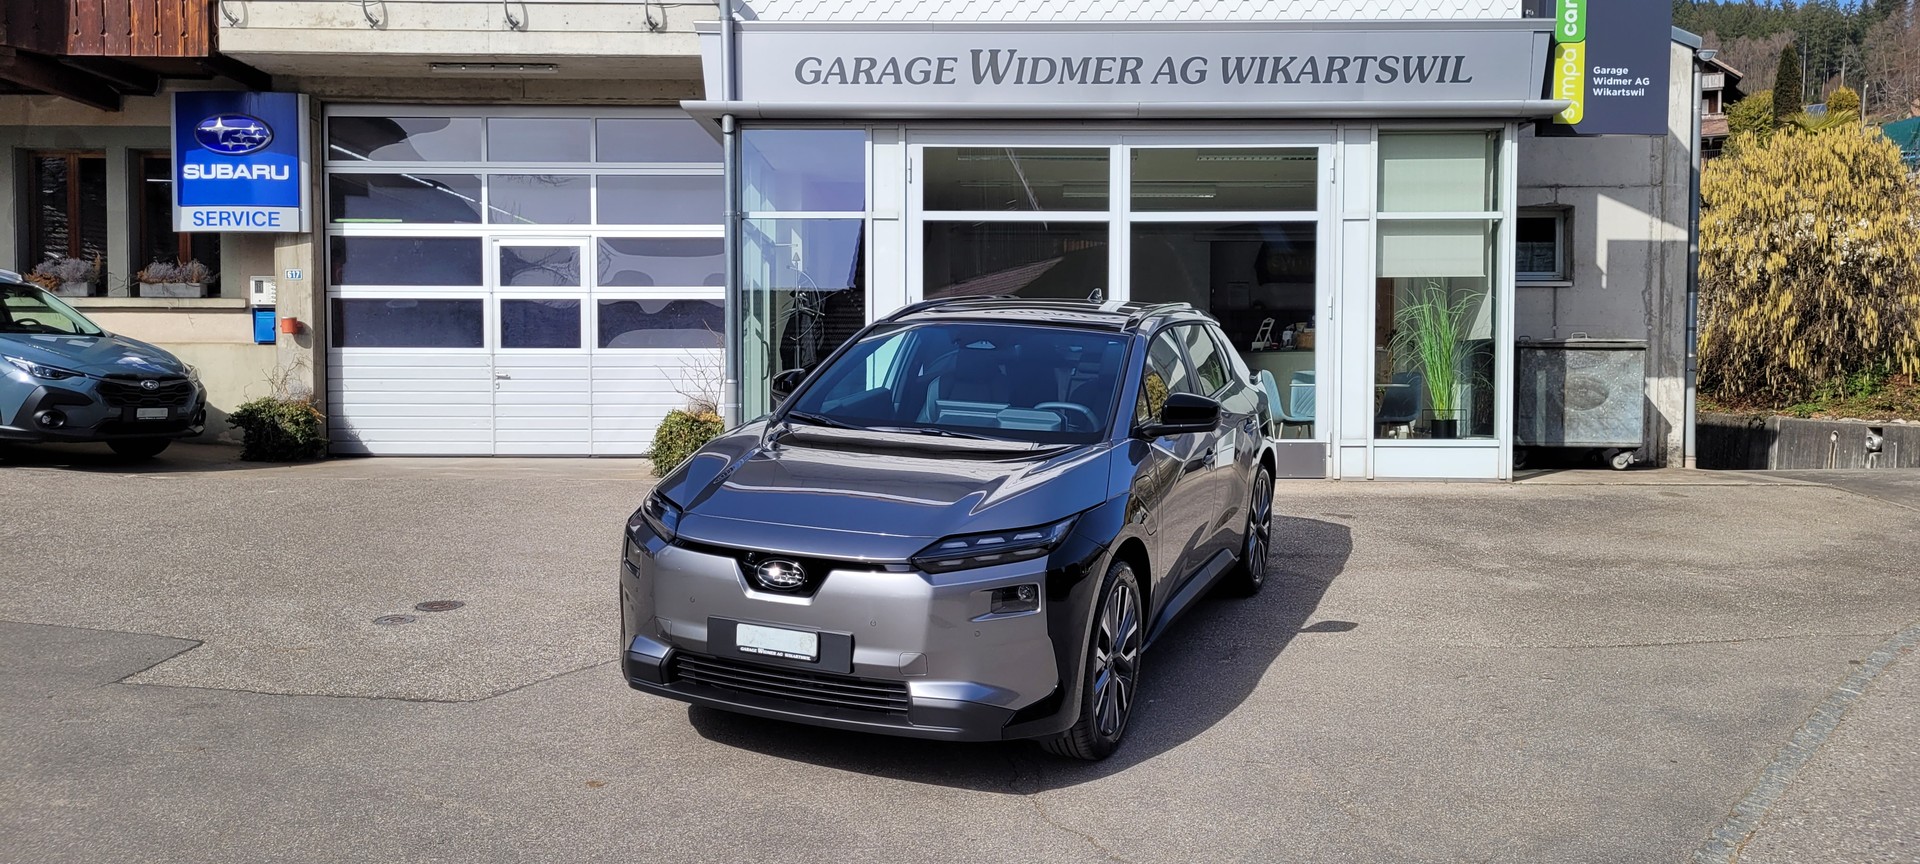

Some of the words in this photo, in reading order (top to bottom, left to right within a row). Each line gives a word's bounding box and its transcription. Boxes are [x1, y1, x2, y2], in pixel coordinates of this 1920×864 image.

[1564, 0, 1578, 36] car
[794, 56, 958, 85] GARAGE
[969, 48, 1144, 85] WIDMER
[1150, 56, 1208, 85] AG
[1220, 55, 1473, 85] WIKARTSWIL
[1593, 66, 1629, 76] Garage
[1593, 77, 1632, 86] Widmer
[1634, 77, 1650, 86] AG
[1593, 88, 1645, 97] Wikartswil
[183, 164, 289, 180] SUBARU
[193, 211, 281, 227] SERVICE
[287, 270, 300, 279] 617
